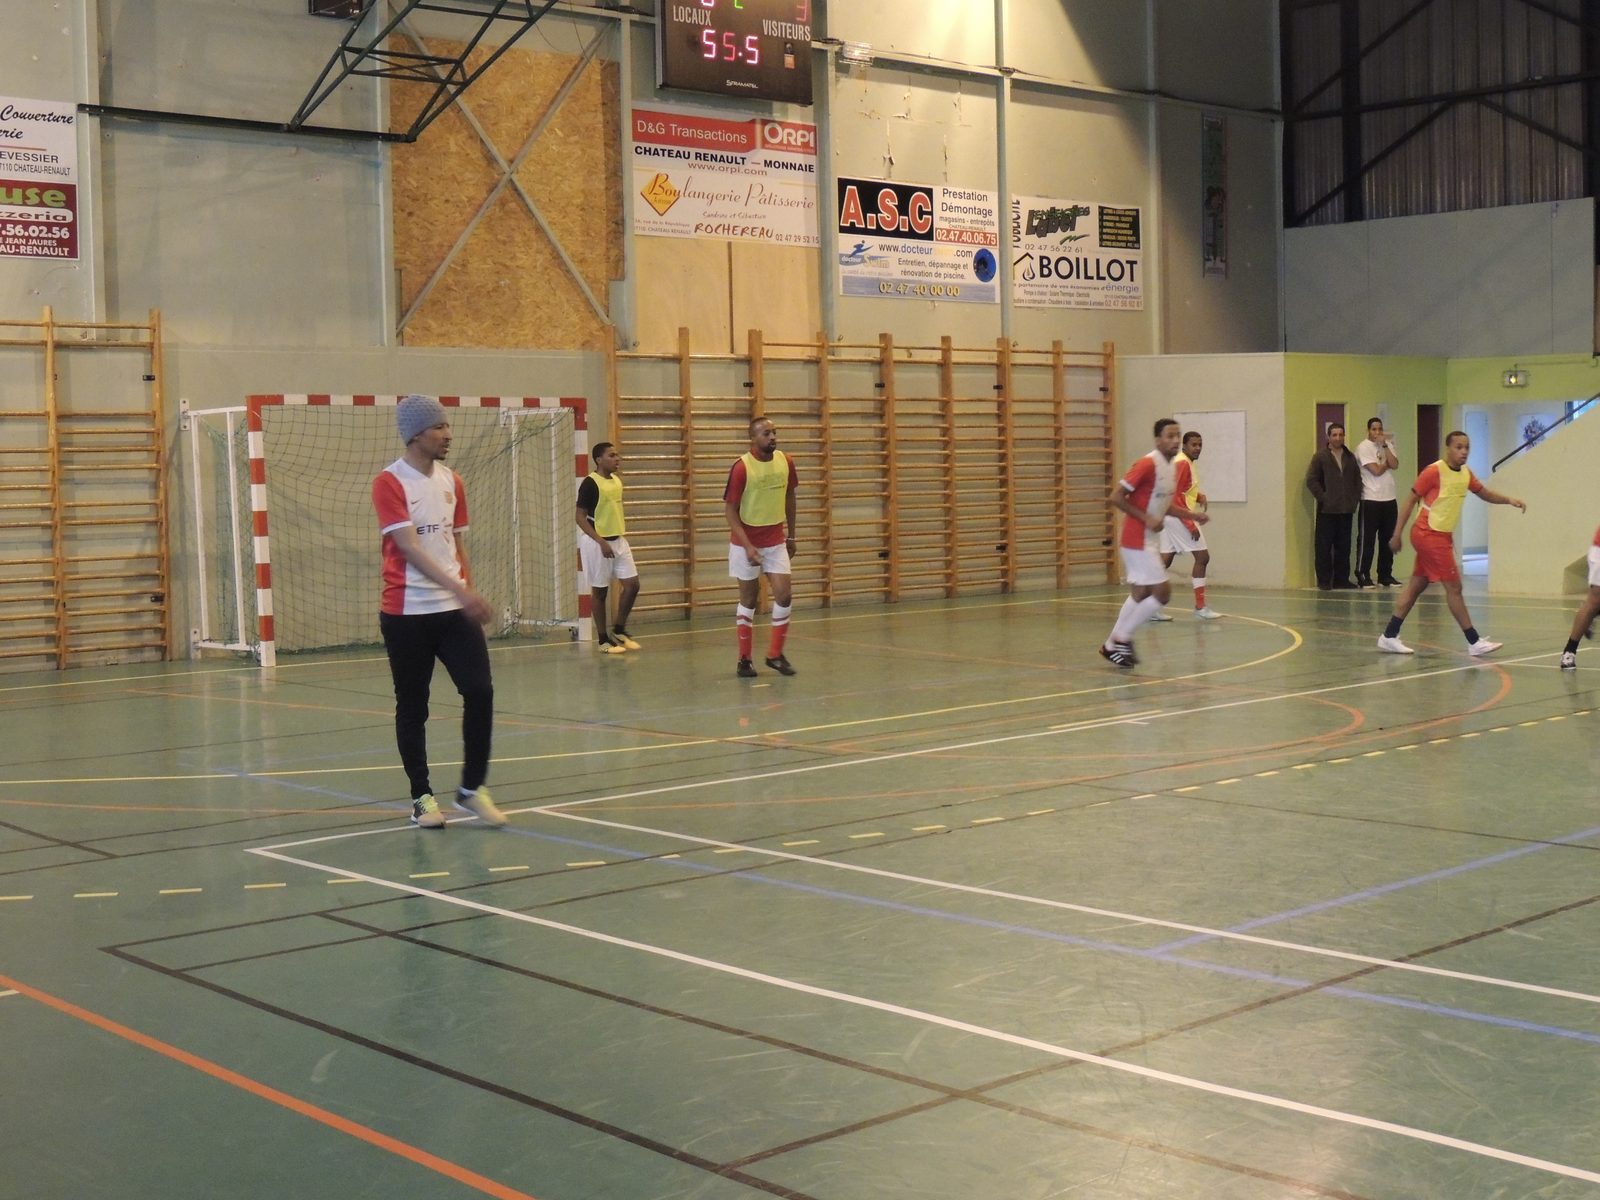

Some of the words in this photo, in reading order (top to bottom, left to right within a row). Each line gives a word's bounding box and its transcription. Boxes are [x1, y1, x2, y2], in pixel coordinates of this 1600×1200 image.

[673, 5, 712, 26] LOCAUX
[763, 19, 811, 41] VISITEURS
[1, 104, 73, 124] Couverture
[637, 120, 665, 135] D&G
[669, 123, 748, 144] Transactions
[764, 122, 815, 146] ORPI
[0, 150, 58, 163] EVESSIER
[634, 146, 691, 160] CHATEAU
[695, 151, 747, 166] RENAULT
[764, 159, 815, 173] MONNAIE
[14, 163, 71, 176] CHATEAU-RENAULT
[687, 162, 768, 176] www.orpi.com
[648, 172, 741, 206] Boulangerie
[745, 182, 815, 209] Pâtisserie
[942, 188, 988, 202] Prestation
[0, 211, 67, 221] zeria
[941, 202, 993, 218] Démontage
[939, 216, 966, 224] magasins
[0, 224, 70, 239] .56.02.56
[694, 222, 774, 239] ROCHEREAU
[936, 229, 996, 245] 02.47.40.06.75
[929, 260, 961, 271] dépannage
[1039, 255, 1138, 282] BOILLOT
[900, 269, 933, 279] rénovation
[934, 271, 942, 279] de
[879, 281, 893, 294] 02
[896, 283, 909, 294] 47
[913, 284, 927, 296] 40
[930, 285, 943, 297] 00
[946, 285, 961, 297] 00
